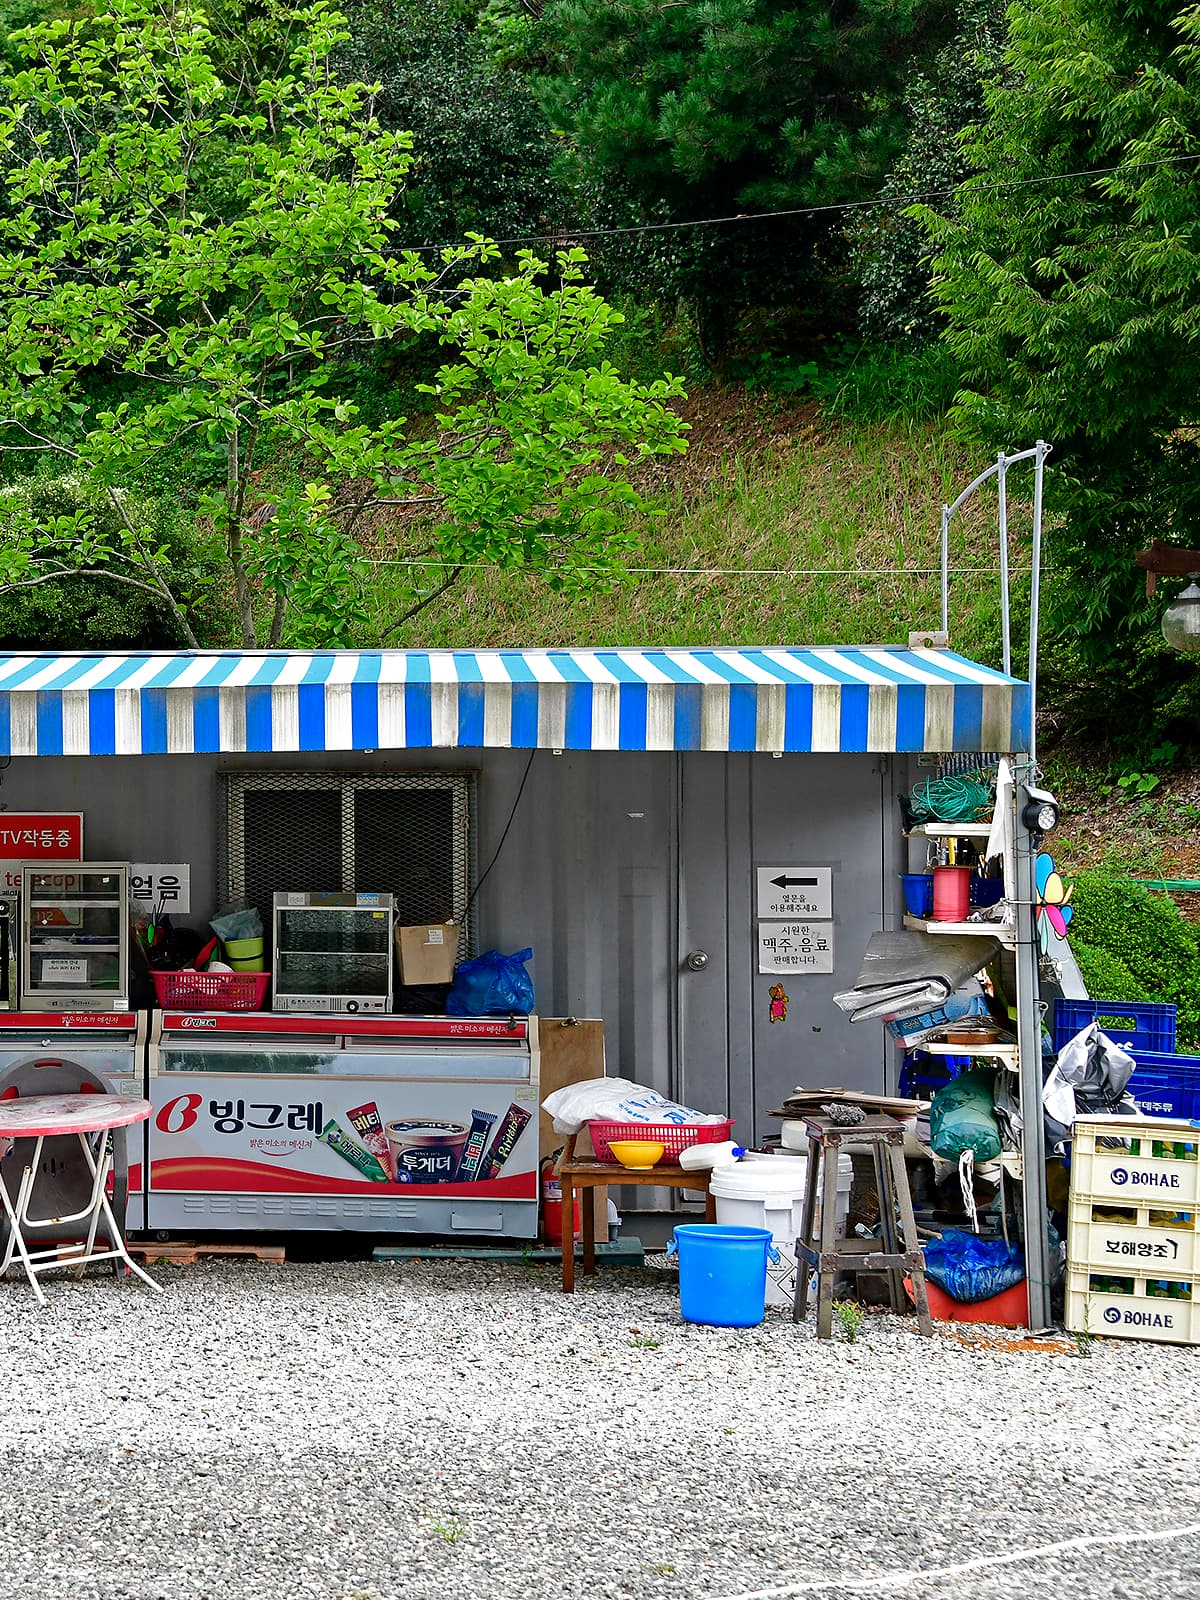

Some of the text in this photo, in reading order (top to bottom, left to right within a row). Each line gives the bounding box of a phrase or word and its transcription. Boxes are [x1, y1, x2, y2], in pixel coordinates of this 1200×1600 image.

[5, 872, 76, 890] teecop
[131, 875, 181, 901] 얼음
[770, 903, 818, 912] 이용해주세요
[782, 894, 807, 903] 옆문을
[781, 926, 810, 936] 시원한
[209, 1099, 323, 1135] 빙그레
[250, 1139, 313, 1149] 밝은 미소의 메신저
[461, 1131, 486, 1172] 비비빅
[340, 1140, 370, 1168] 메로나
[402, 1154, 451, 1173] 투게더
[1131, 1171, 1180, 1188] BOHAE
[1106, 1240, 1168, 1258] 보해양조
[1124, 1310, 1174, 1328] BOHAE
